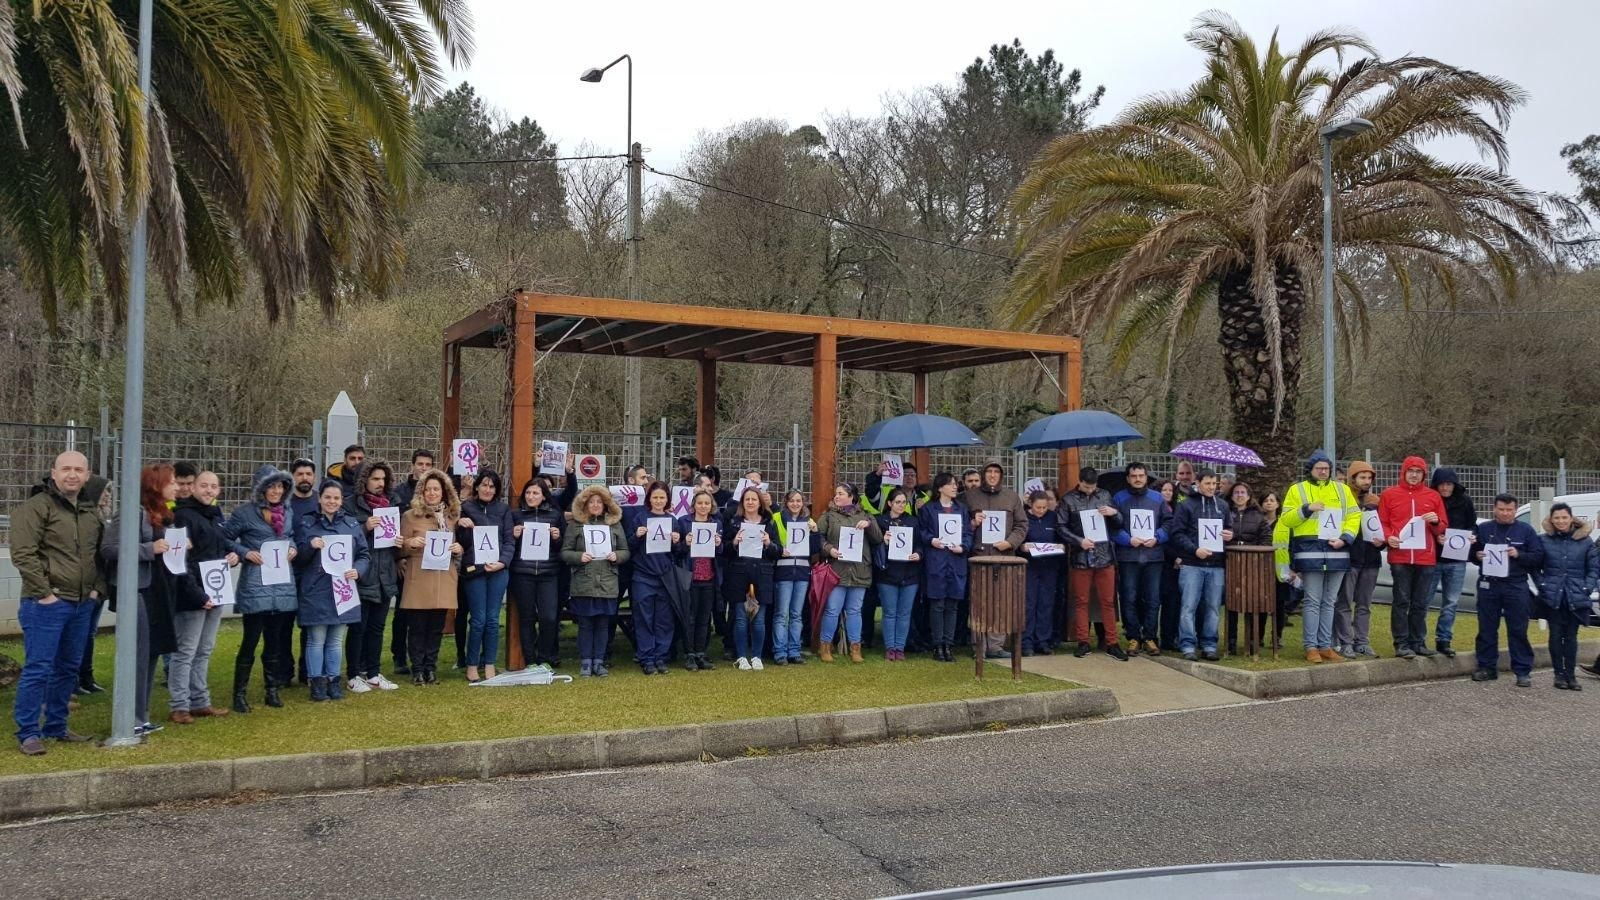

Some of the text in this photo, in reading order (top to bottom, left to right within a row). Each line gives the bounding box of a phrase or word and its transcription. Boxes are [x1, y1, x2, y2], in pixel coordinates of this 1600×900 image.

[944, 520, 956, 535] C
[987, 516, 1000, 531] R
[1090, 516, 1096, 530] I
[1132, 516, 1152, 530] M
[1324, 513, 1336, 529] A
[1367, 515, 1379, 531] C
[652, 525, 666, 540] A
[696, 529, 711, 544] D
[792, 529, 805, 544] D
[1204, 525, 1217, 540] N
[1408, 521, 1414, 537] I
[479, 533, 493, 550] A
[530, 529, 541, 546] L
[589, 530, 606, 544] D
[849, 534, 854, 549] I
[896, 533, 905, 548] S
[1449, 535, 1465, 550] O
[328, 542, 346, 561] G
[431, 538, 447, 556] U
[273, 549, 280, 568] I
[1488, 550, 1503, 565] N
